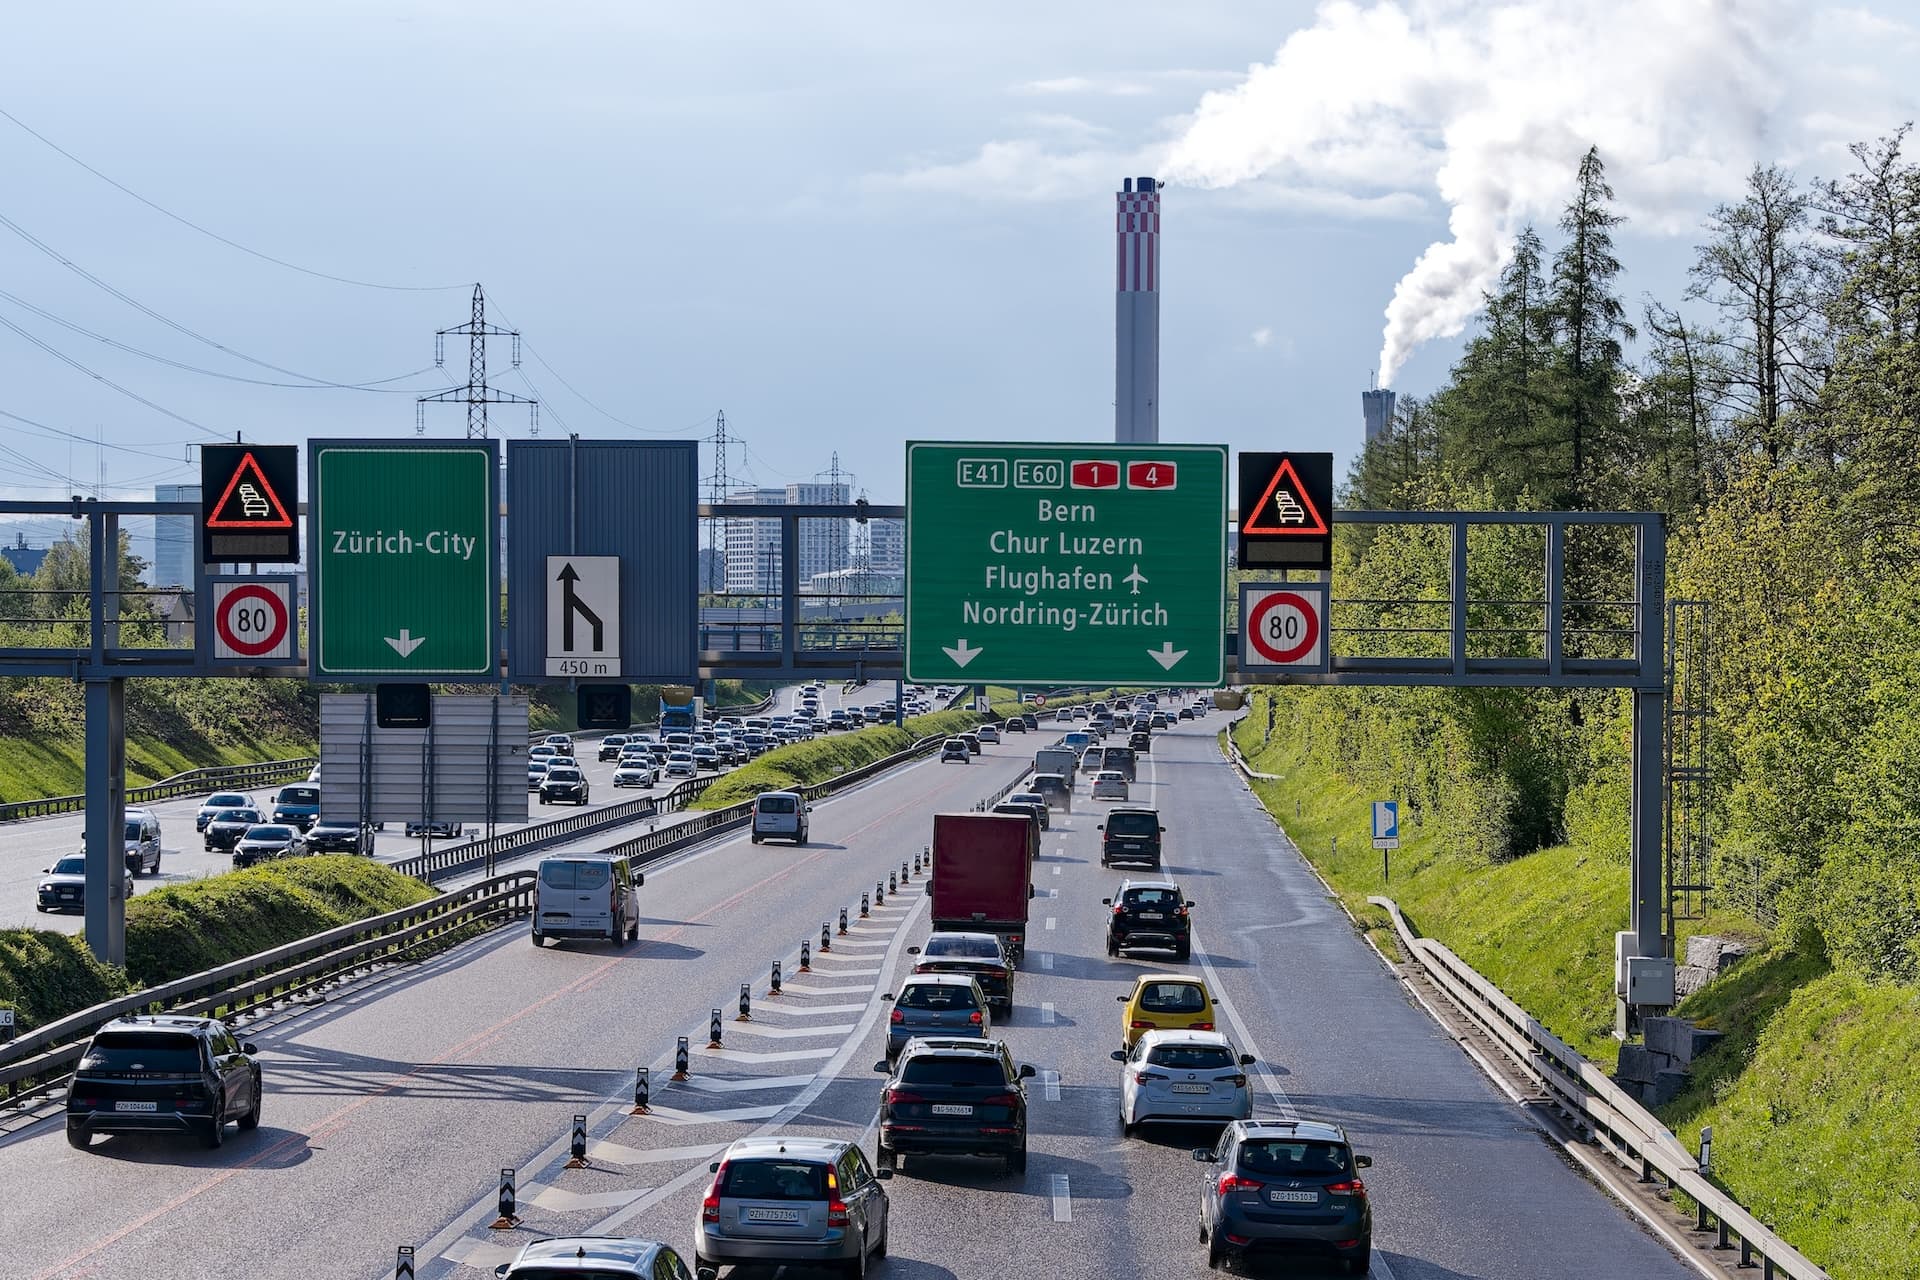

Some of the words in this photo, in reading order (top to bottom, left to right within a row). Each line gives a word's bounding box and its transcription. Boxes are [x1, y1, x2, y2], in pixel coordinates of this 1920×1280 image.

[962, 464, 999, 483] E41
[1018, 465, 1058, 484] E60
[1090, 466, 1099, 484] 1
[1145, 466, 1158, 485] 4
[1038, 499, 1096, 522] Bern
[332, 529, 476, 561] Zürich-City
[989, 530, 1049, 554] Chur
[1059, 532, 1143, 555] Luzern
[985, 565, 1113, 596] Flughafen
[238, 608, 267, 632] 80
[963, 601, 1168, 631] Nordring-Zürich
[1269, 616, 1298, 640] 80
[559, 660, 588, 674] 450
[594, 664, 608, 674] m
